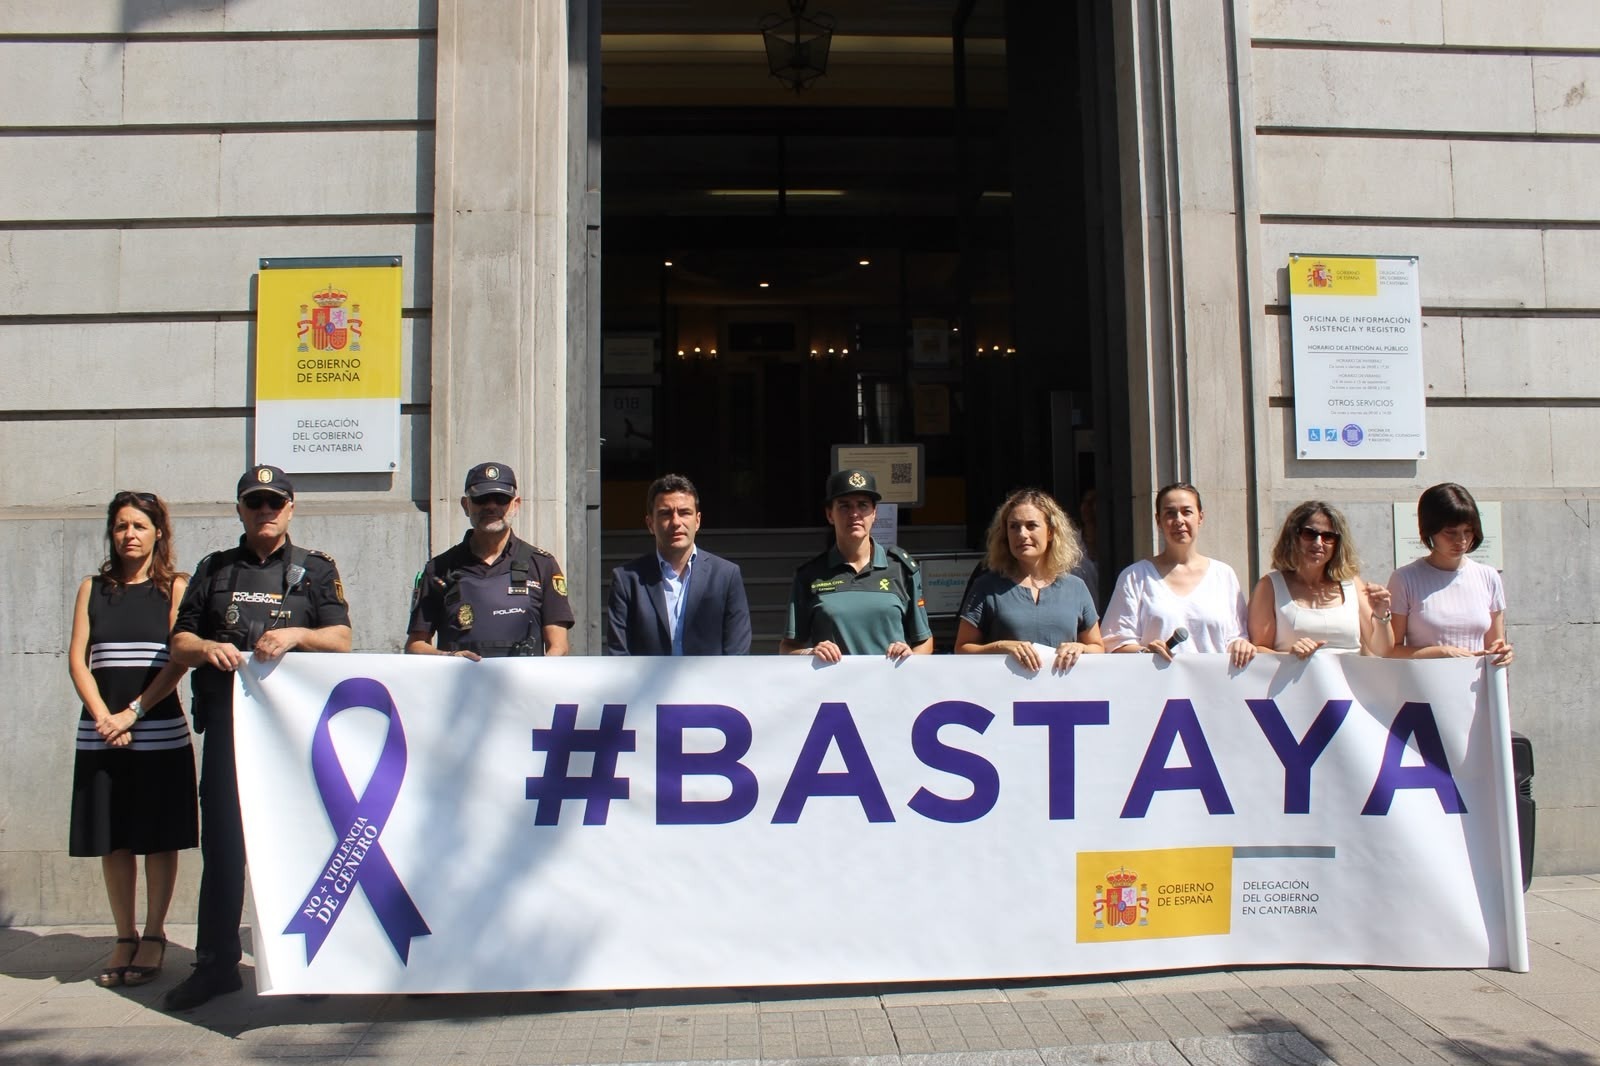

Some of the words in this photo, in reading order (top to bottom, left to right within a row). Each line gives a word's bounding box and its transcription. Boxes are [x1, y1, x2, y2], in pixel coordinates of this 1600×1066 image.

[1353, 315, 1411, 324] INFORMACIÓN
[297, 358, 361, 370] GOBIERNO
[297, 372, 312, 382] DE
[316, 370, 360, 382] ESPAÑA
[297, 418, 359, 428] DELEGACIÓN
[293, 432, 310, 441] DEL
[312, 431, 364, 441] GOBIERNO
[293, 444, 306, 453] EN
[309, 444, 363, 453] CANTABRIA
[525, 698, 1469, 826] #BASTAYA
[303, 895, 322, 920] NO
[323, 816, 368, 882] VIOLENCIA
[316, 895, 340, 926] DE
[334, 824, 378, 894] GENERO
[1158, 882, 1214, 895] GOBIERNO
[1243, 879, 1309, 890] DELEGACIÓN
[1157, 896, 1171, 907] DE
[1174, 892, 1213, 906] ESPAÑA
[1243, 893, 1262, 903] DEL
[1264, 892, 1319, 903] GOBIERNO
[1242, 906, 1256, 915] EN
[1259, 905, 1318, 915] CANTABRIA
